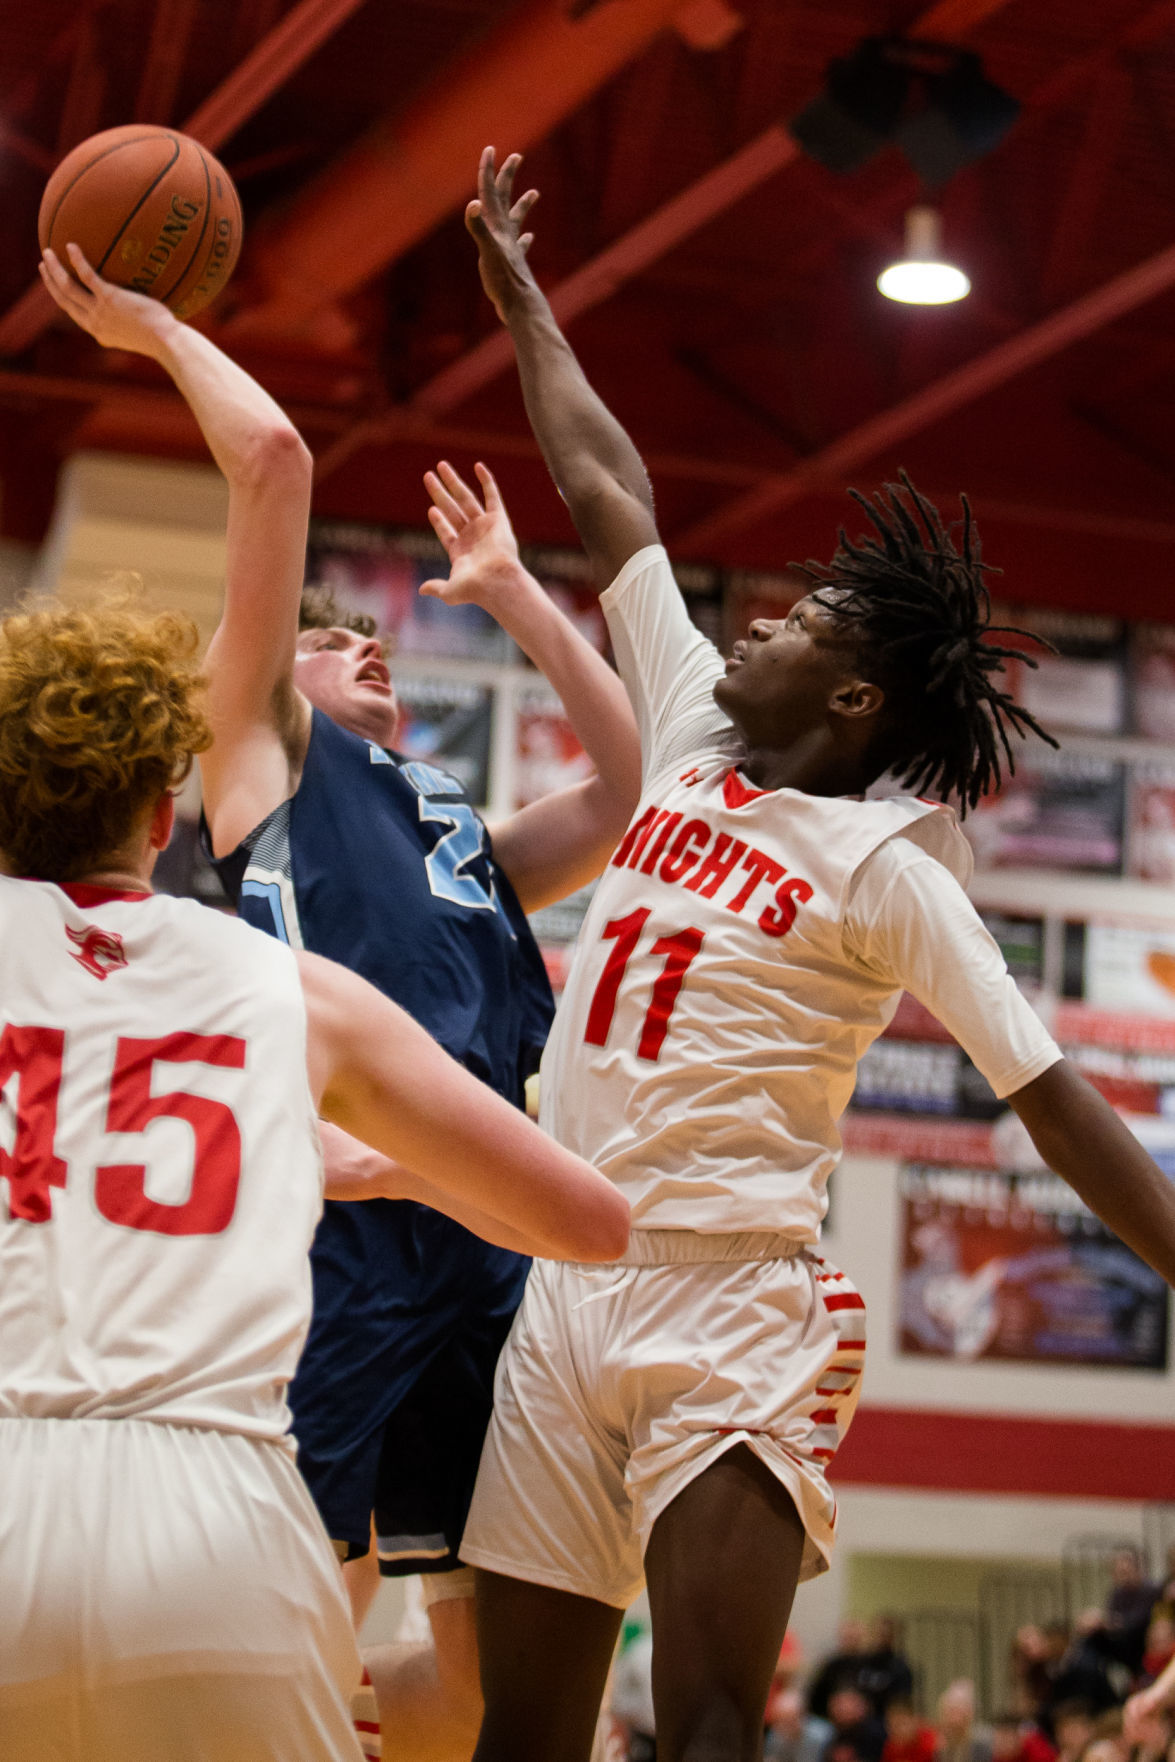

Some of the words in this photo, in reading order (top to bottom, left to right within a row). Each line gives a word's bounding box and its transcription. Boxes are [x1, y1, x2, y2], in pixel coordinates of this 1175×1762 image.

[126, 194, 200, 294] ALDING
[611, 804, 815, 938] NIGHTS
[583, 905, 707, 1064] 11
[0, 1022, 247, 1237] 45
